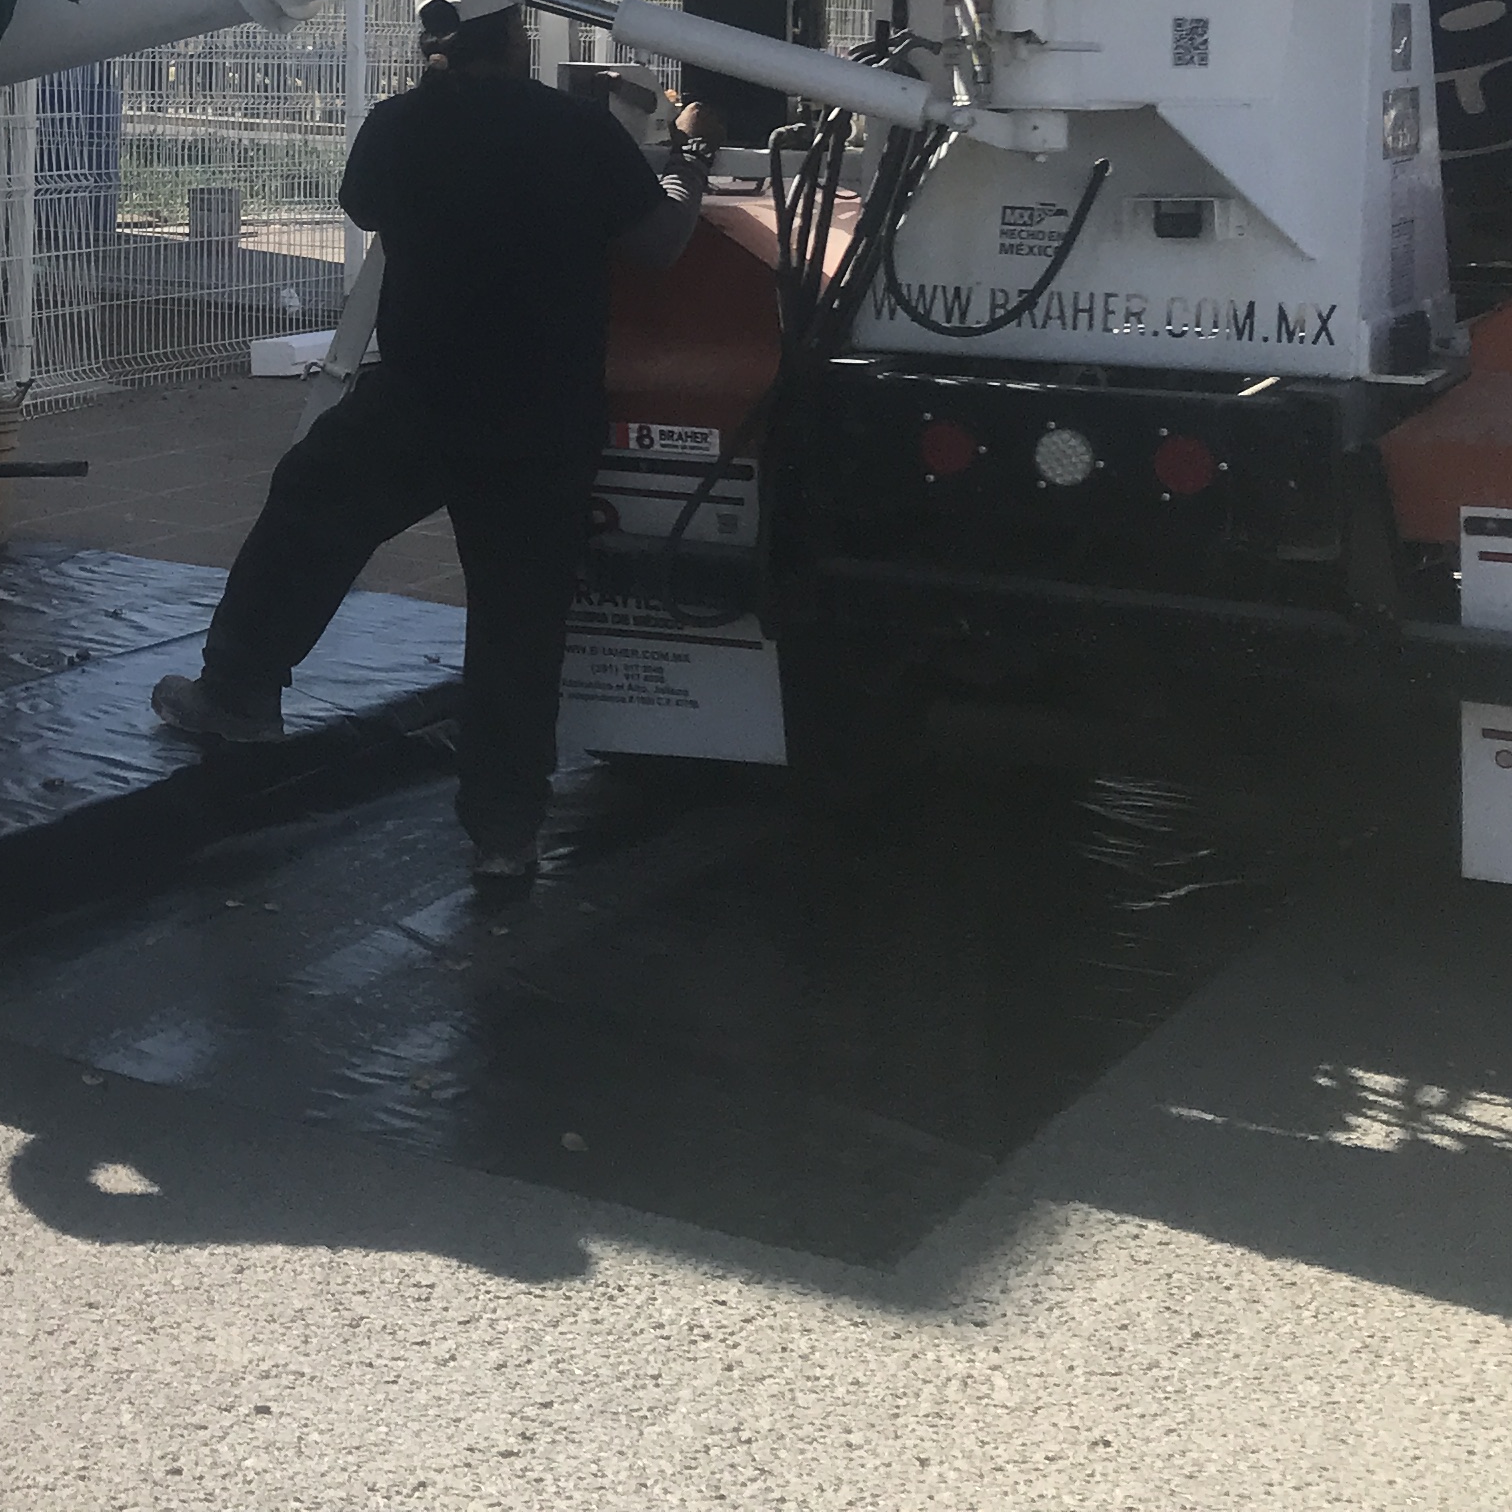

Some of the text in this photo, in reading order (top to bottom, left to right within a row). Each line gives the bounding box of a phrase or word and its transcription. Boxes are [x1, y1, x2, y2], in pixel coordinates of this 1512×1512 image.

[999, 229, 1045, 241] HECHO
[999, 241, 1060, 258] MÉXIC
[658, 429, 709, 444] BRAHER
